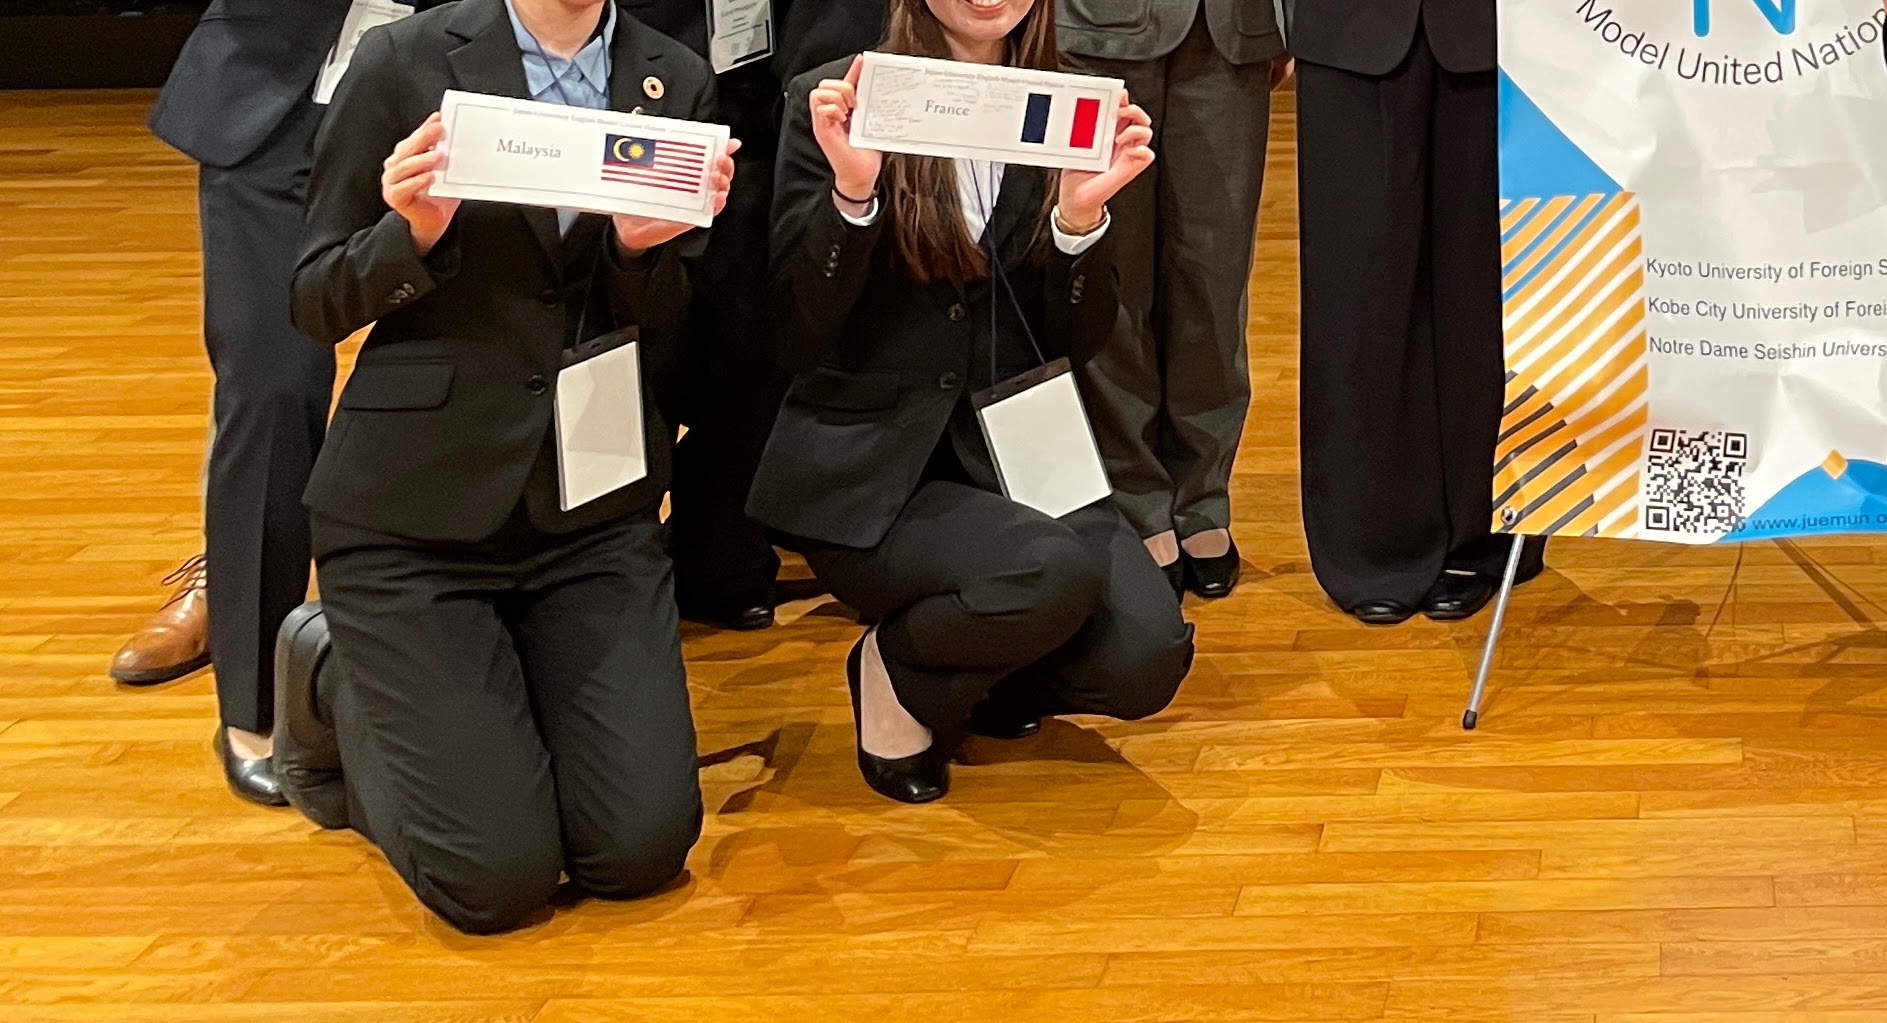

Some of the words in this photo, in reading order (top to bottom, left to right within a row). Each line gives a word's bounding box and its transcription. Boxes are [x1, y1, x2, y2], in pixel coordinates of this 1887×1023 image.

[1677, 47, 1784, 86] United
[924, 99, 971, 117] France
[496, 138, 562, 159] Malaysia
[1646, 258, 1692, 278] Kyoto
[1698, 261, 1783, 284] University
[1787, 260, 1804, 279] of
[1810, 260, 1873, 280] Foreign
[1648, 297, 1690, 316] Kobe
[1695, 299, 1727, 321] City
[1732, 302, 1818, 323] University
[1823, 300, 1840, 319] of
[1649, 336, 1694, 355] Notre
[1700, 340, 1749, 359] Dame
[1755, 342, 1816, 360] Seishin
